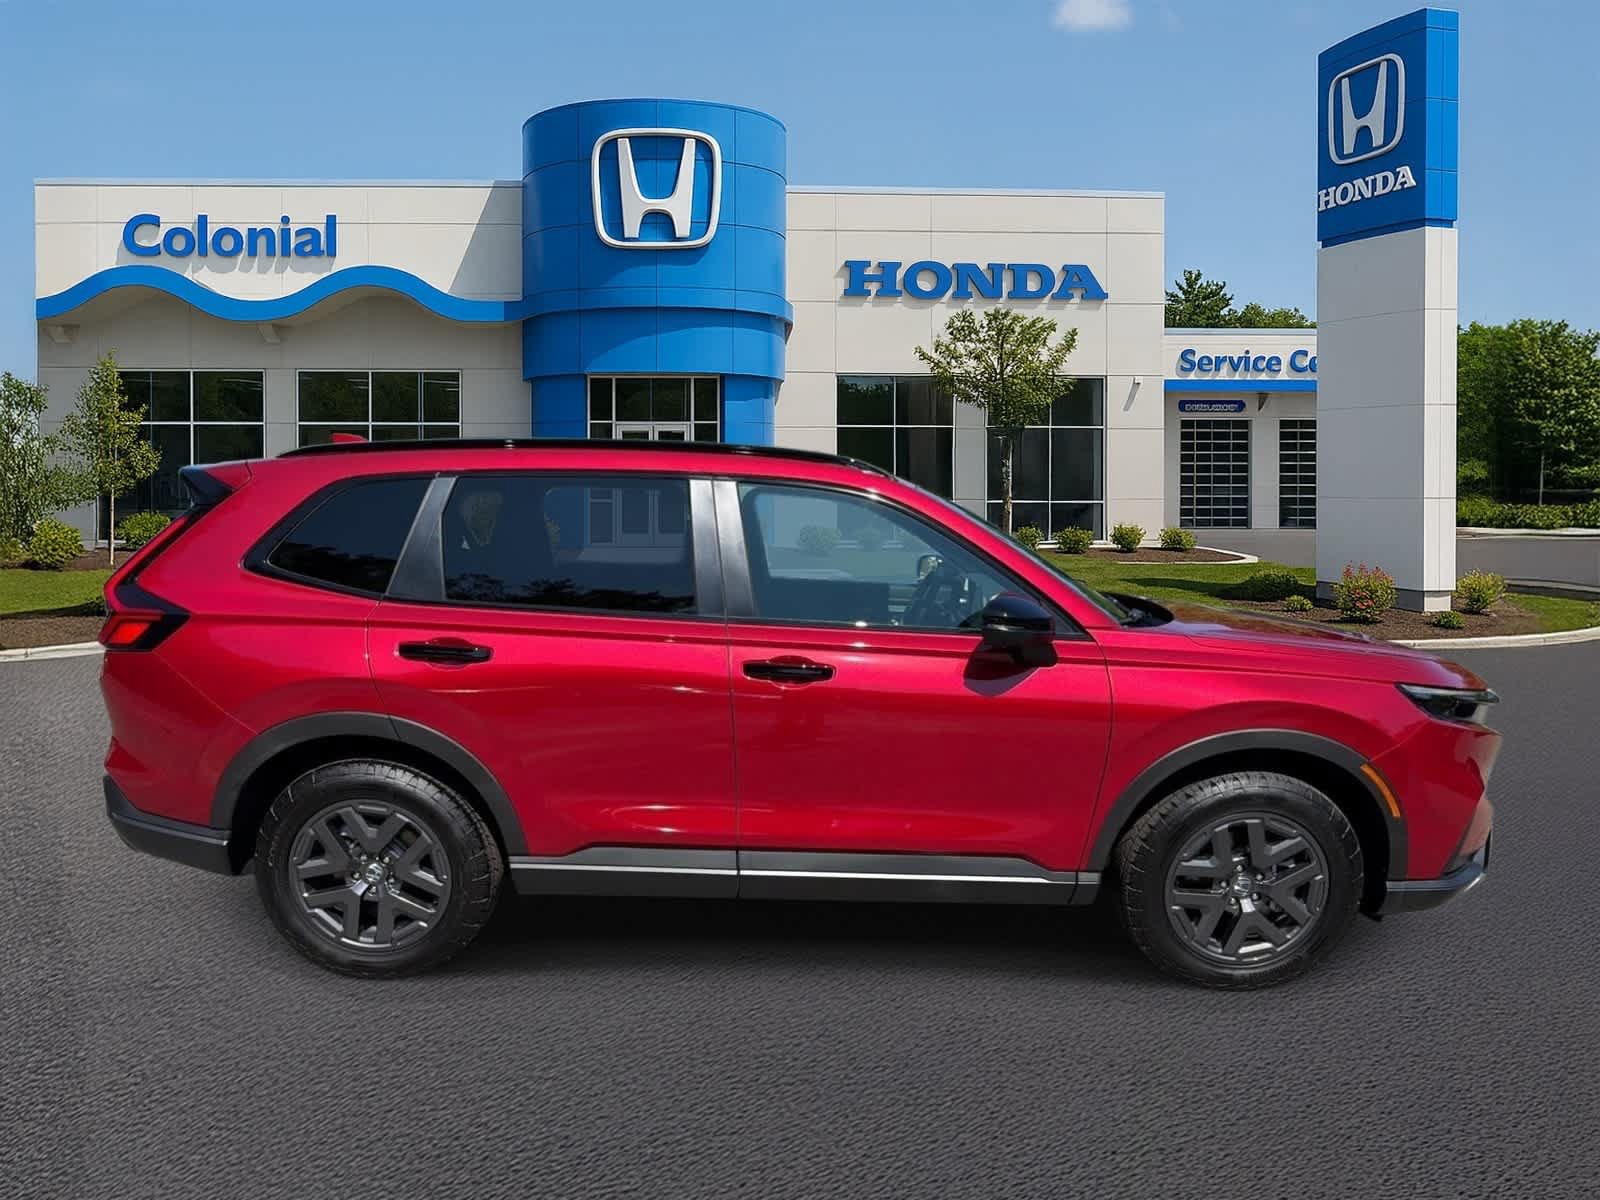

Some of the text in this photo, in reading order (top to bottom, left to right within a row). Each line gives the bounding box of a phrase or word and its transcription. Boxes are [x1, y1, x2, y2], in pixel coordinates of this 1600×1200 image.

[1318, 165, 1417, 212] HONDA
[122, 213, 338, 258] Colonial
[843, 260, 1109, 300] HONDA
[1179, 348, 1282, 373] Service
